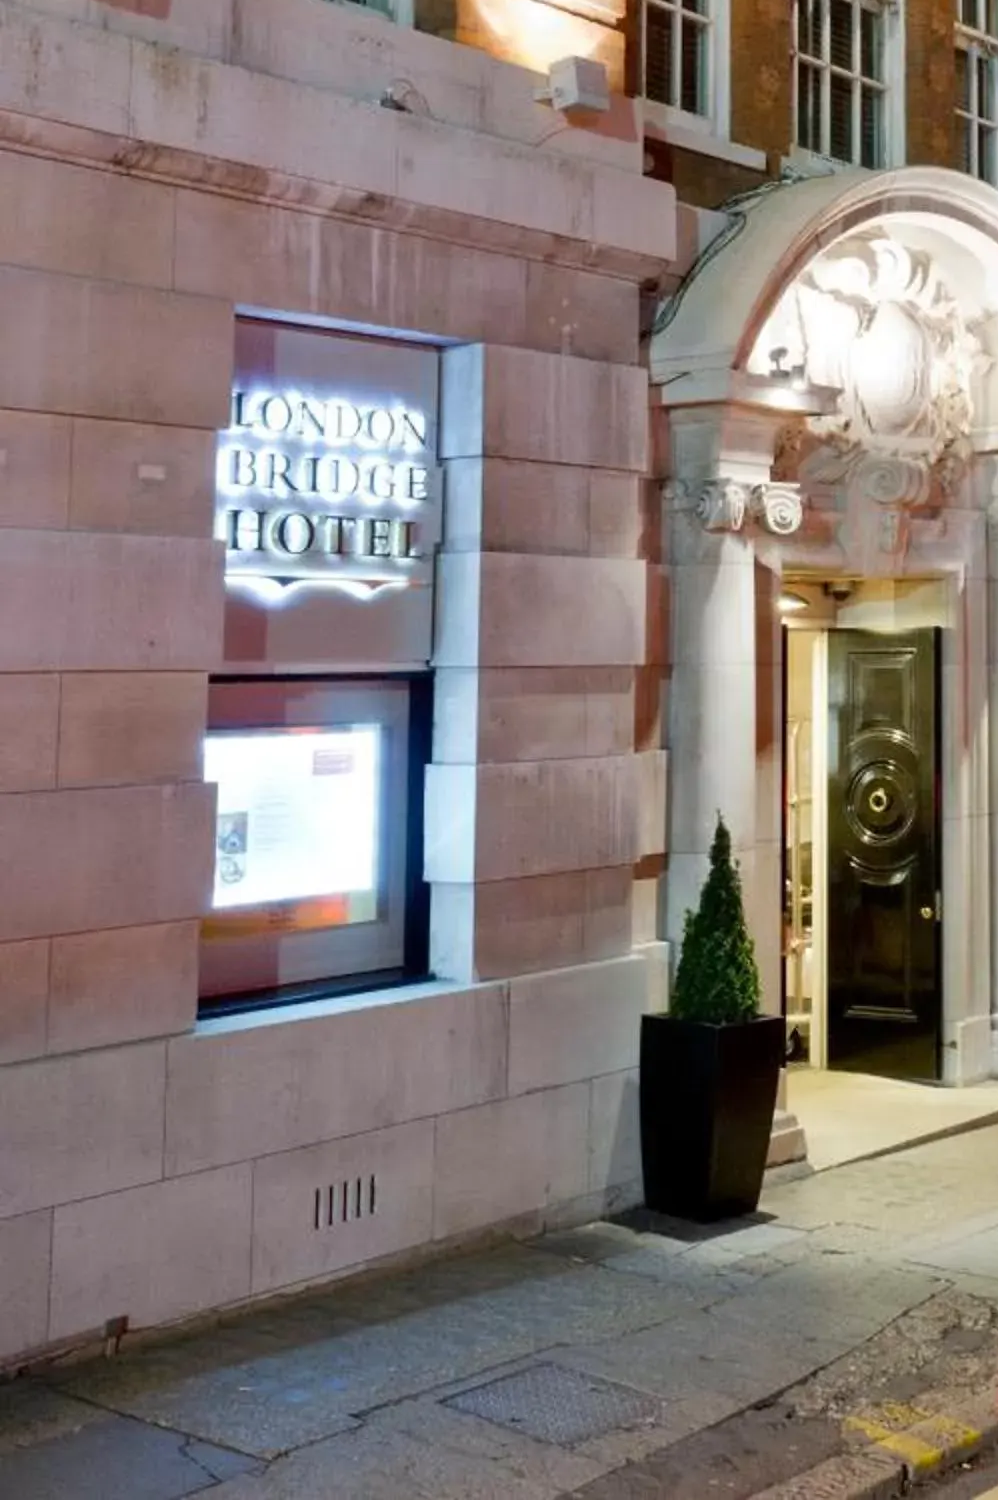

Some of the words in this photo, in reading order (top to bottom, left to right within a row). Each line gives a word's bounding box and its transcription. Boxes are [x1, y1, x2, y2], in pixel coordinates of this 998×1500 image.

[232, 391, 427, 446] LONDON
[231, 449, 428, 501] BRIDGE
[227, 508, 423, 559] HOTEL
